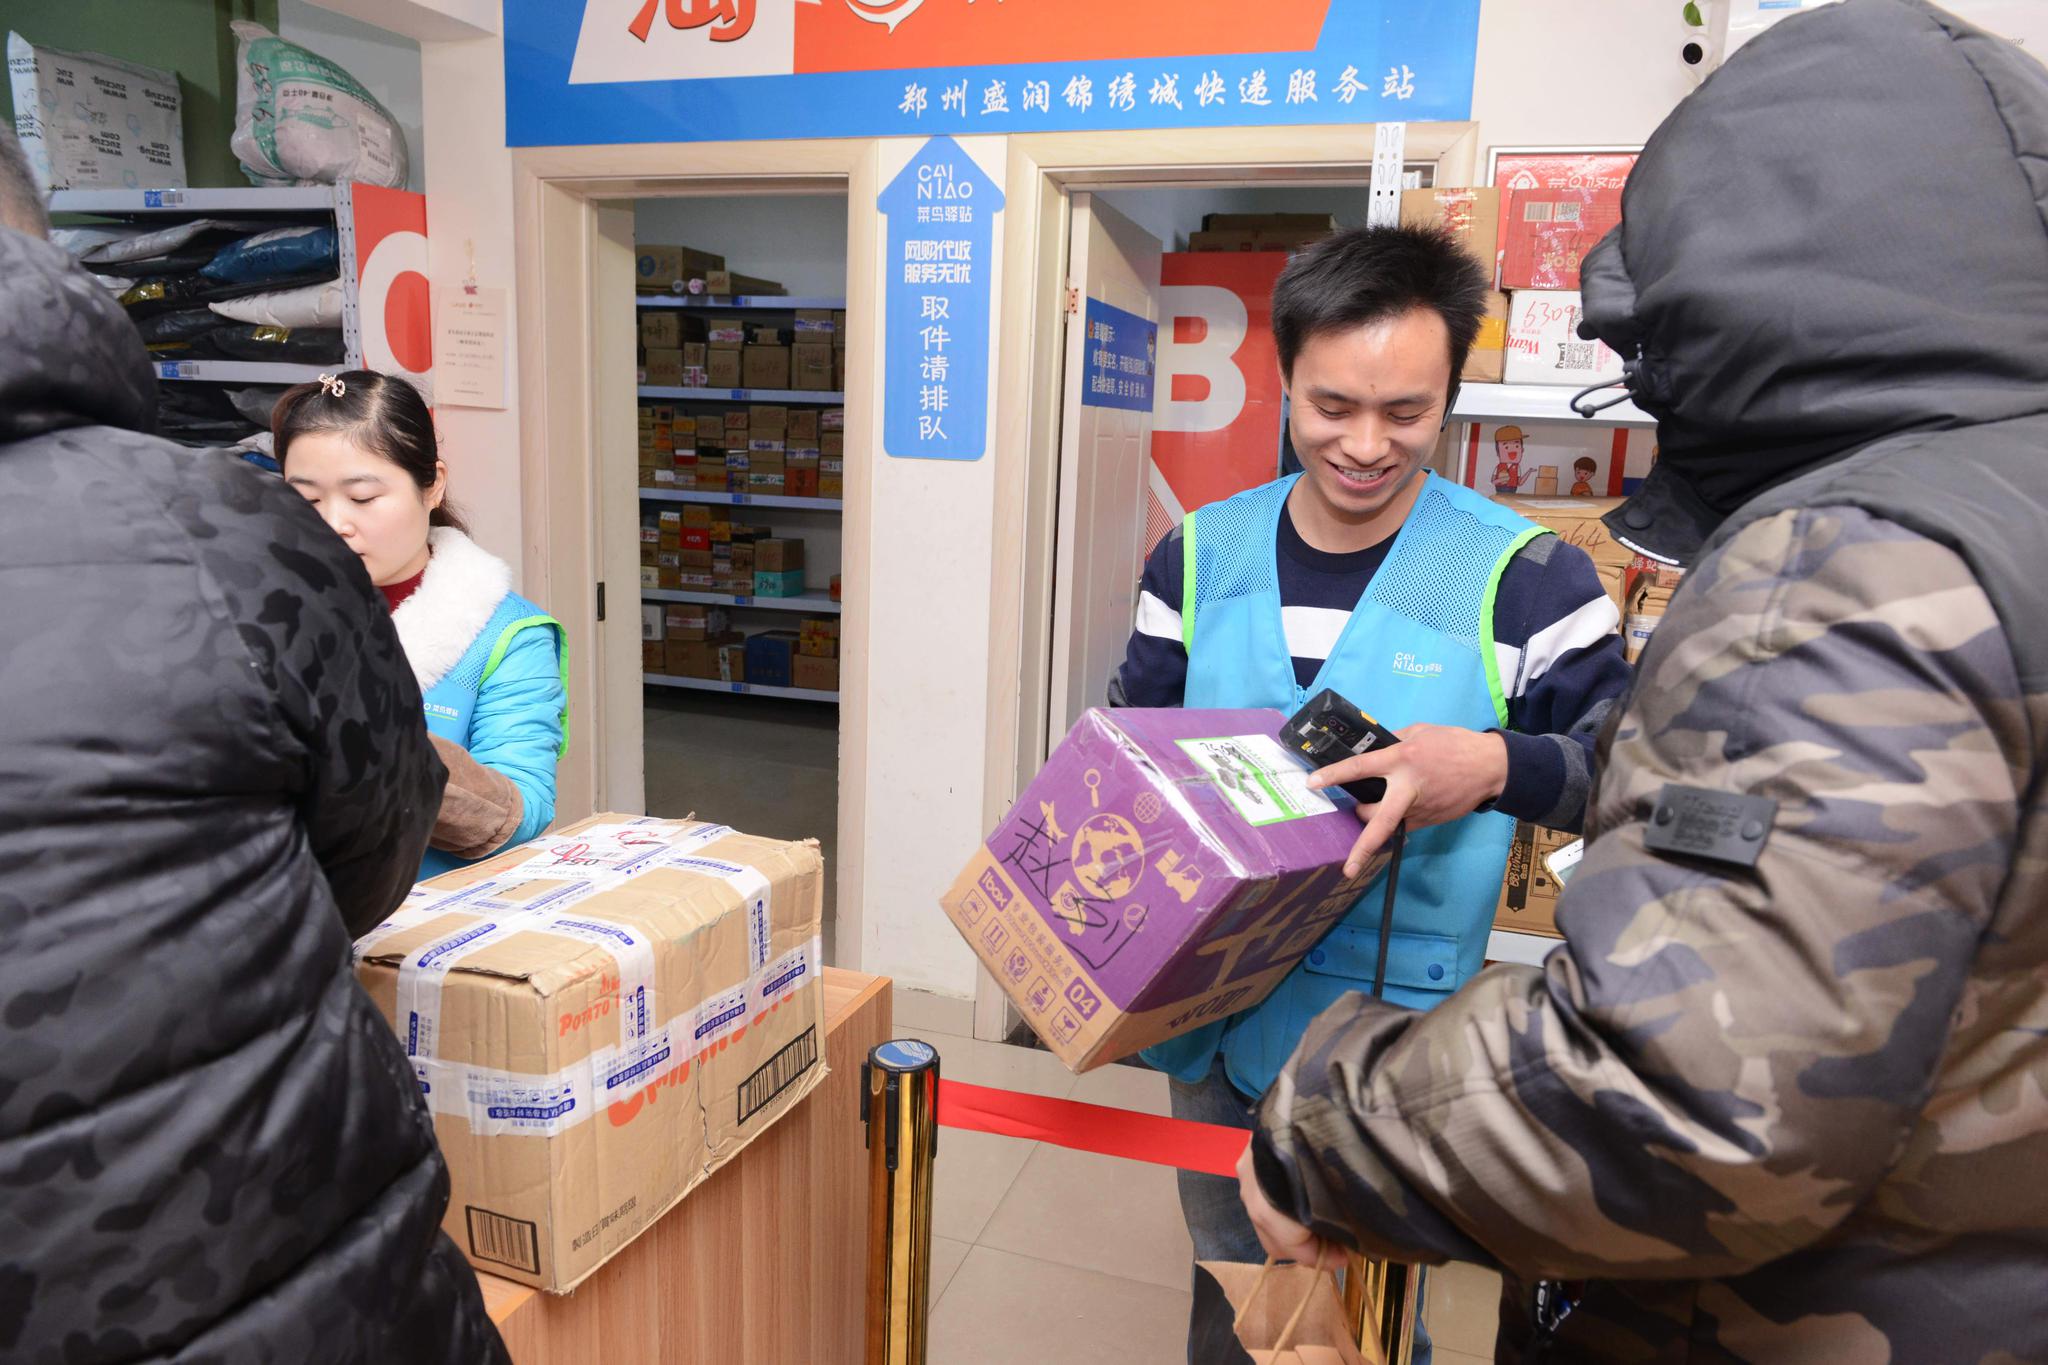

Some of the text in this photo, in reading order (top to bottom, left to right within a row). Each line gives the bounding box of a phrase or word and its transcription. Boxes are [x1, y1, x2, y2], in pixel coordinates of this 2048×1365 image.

[897, 62, 1418, 120] 郑州盛润锦绣城快递服务站
[917, 164, 954, 183] CAI
[917, 205, 972, 224] 菜鸟驿站
[905, 240, 971, 262] 网购代收
[904, 263, 971, 284] 服务无忧
[918, 295, 951, 442] 取件请排队
[1152, 284, 1248, 432] B
[1069, 982, 1097, 1016] 04
